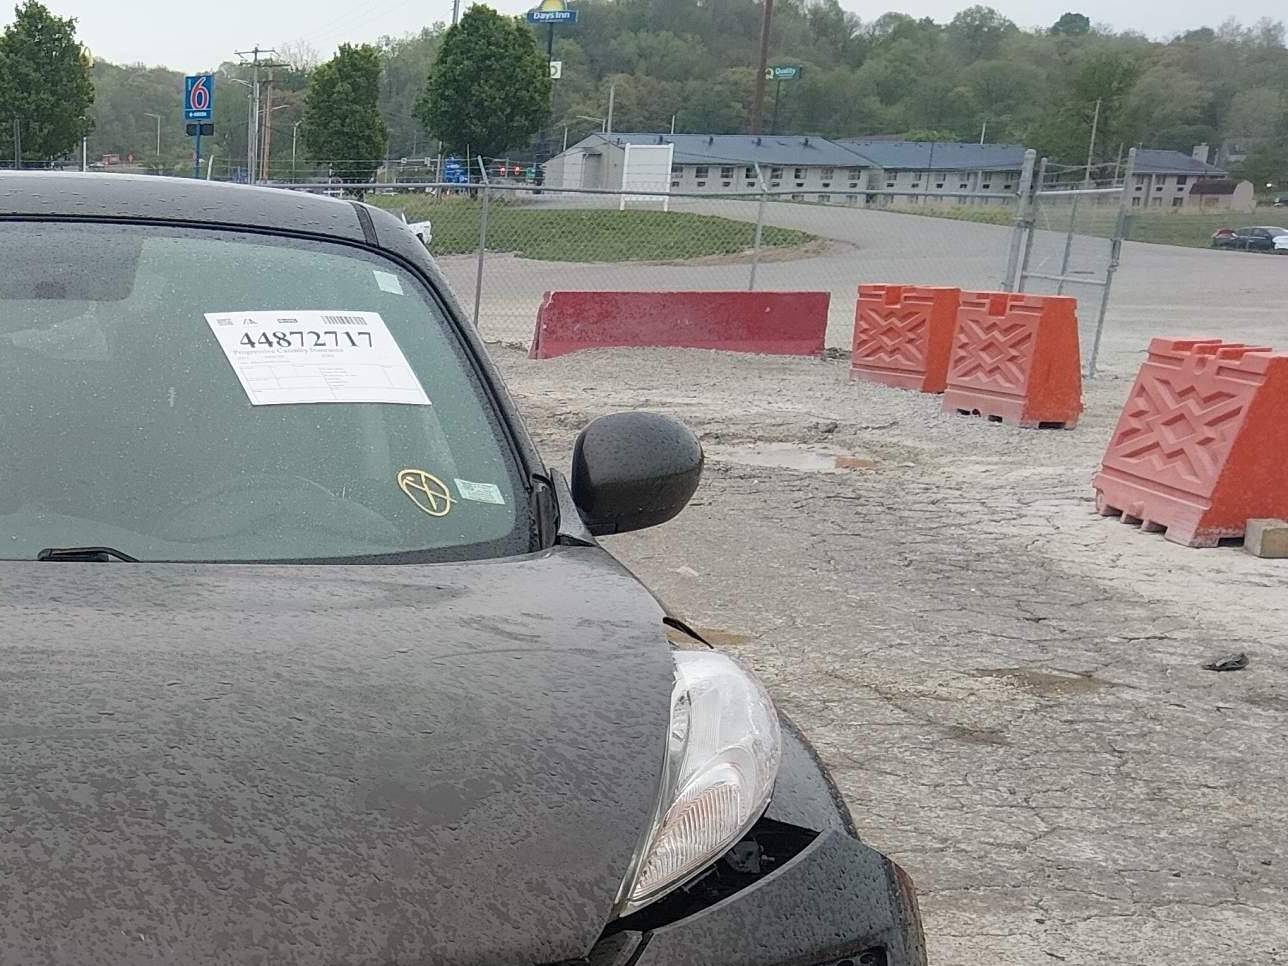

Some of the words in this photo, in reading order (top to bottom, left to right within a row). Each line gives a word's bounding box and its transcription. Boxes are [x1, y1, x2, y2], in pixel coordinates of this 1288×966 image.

[533, 12, 554, 20] Days
[190, 76, 210, 110] 6
[240, 331, 372, 348] 44872717
